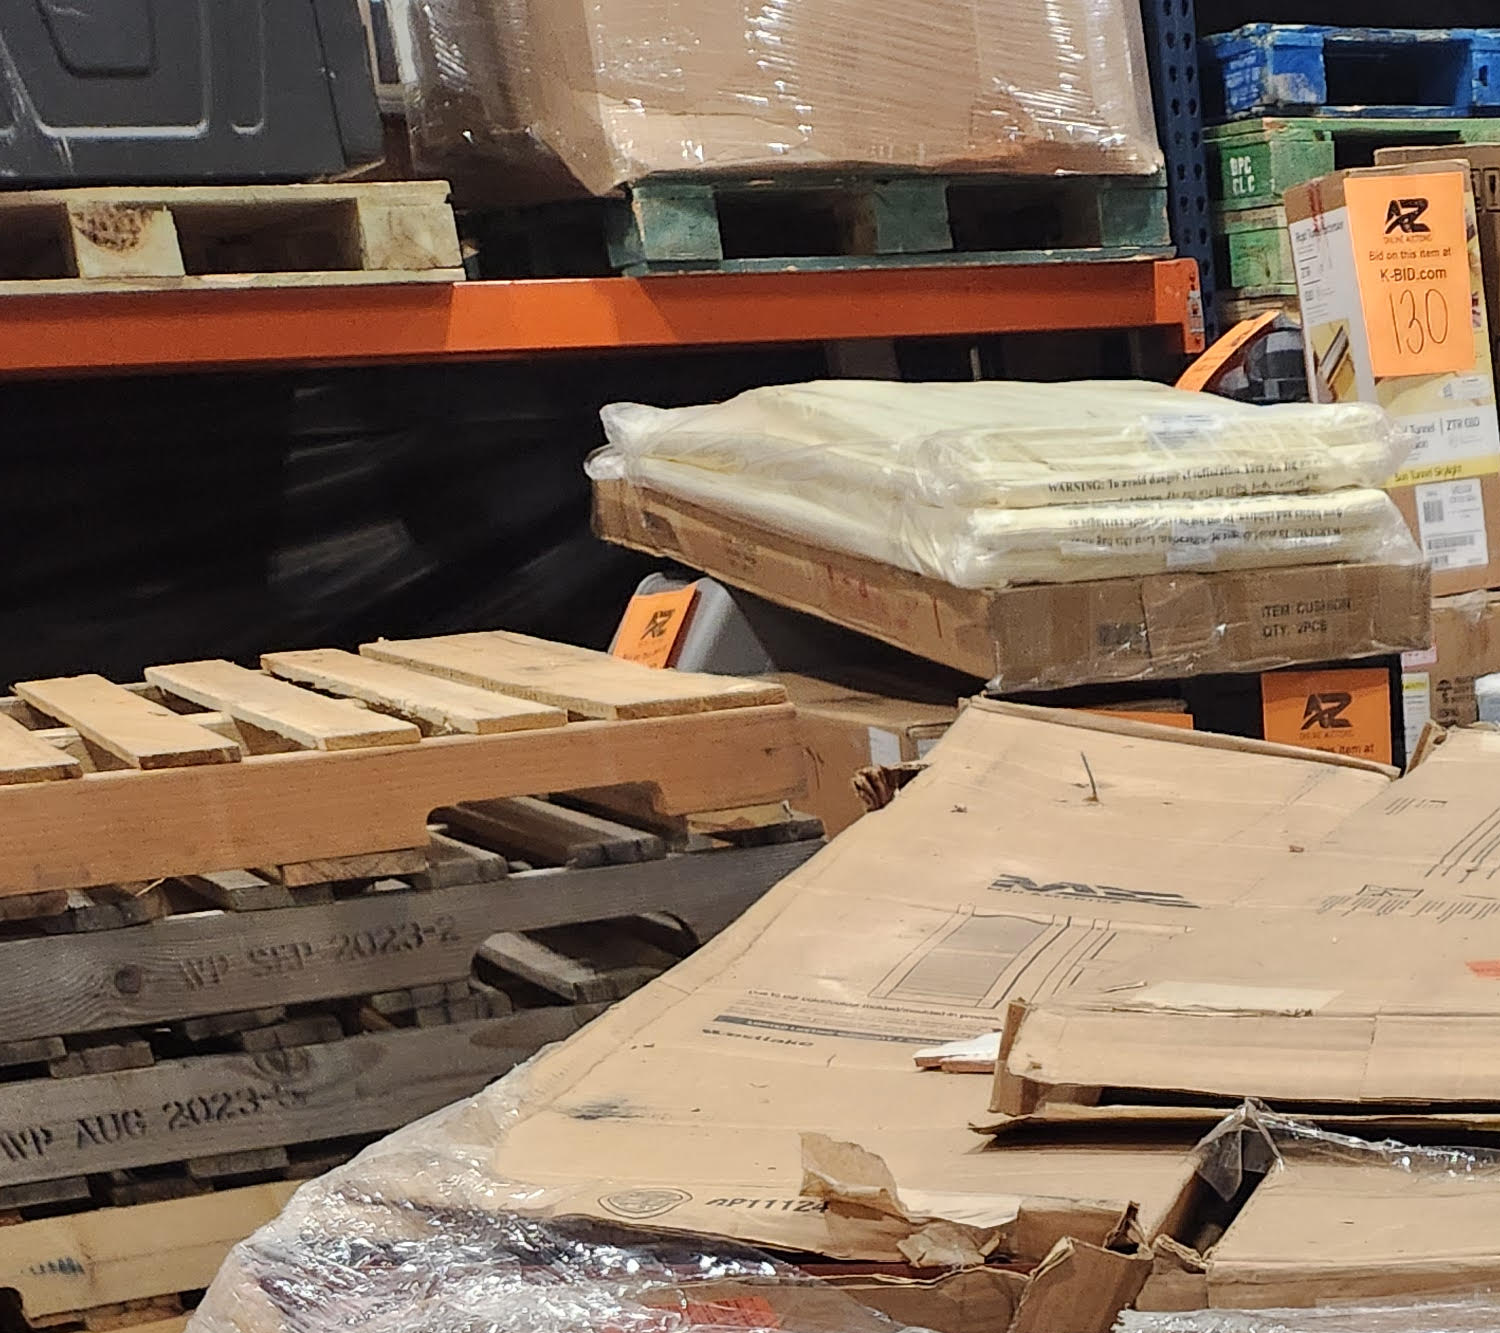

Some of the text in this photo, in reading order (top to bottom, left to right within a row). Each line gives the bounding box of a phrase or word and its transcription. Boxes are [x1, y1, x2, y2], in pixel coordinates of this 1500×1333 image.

[1369, 248, 1452, 261] Bid on this item at
[1380, 268, 1448, 282] K-BID.com
[1389, 288, 1449, 355] 130
[1339, 744, 1375, 755] item at
[77, 1108, 146, 1149] AUG
